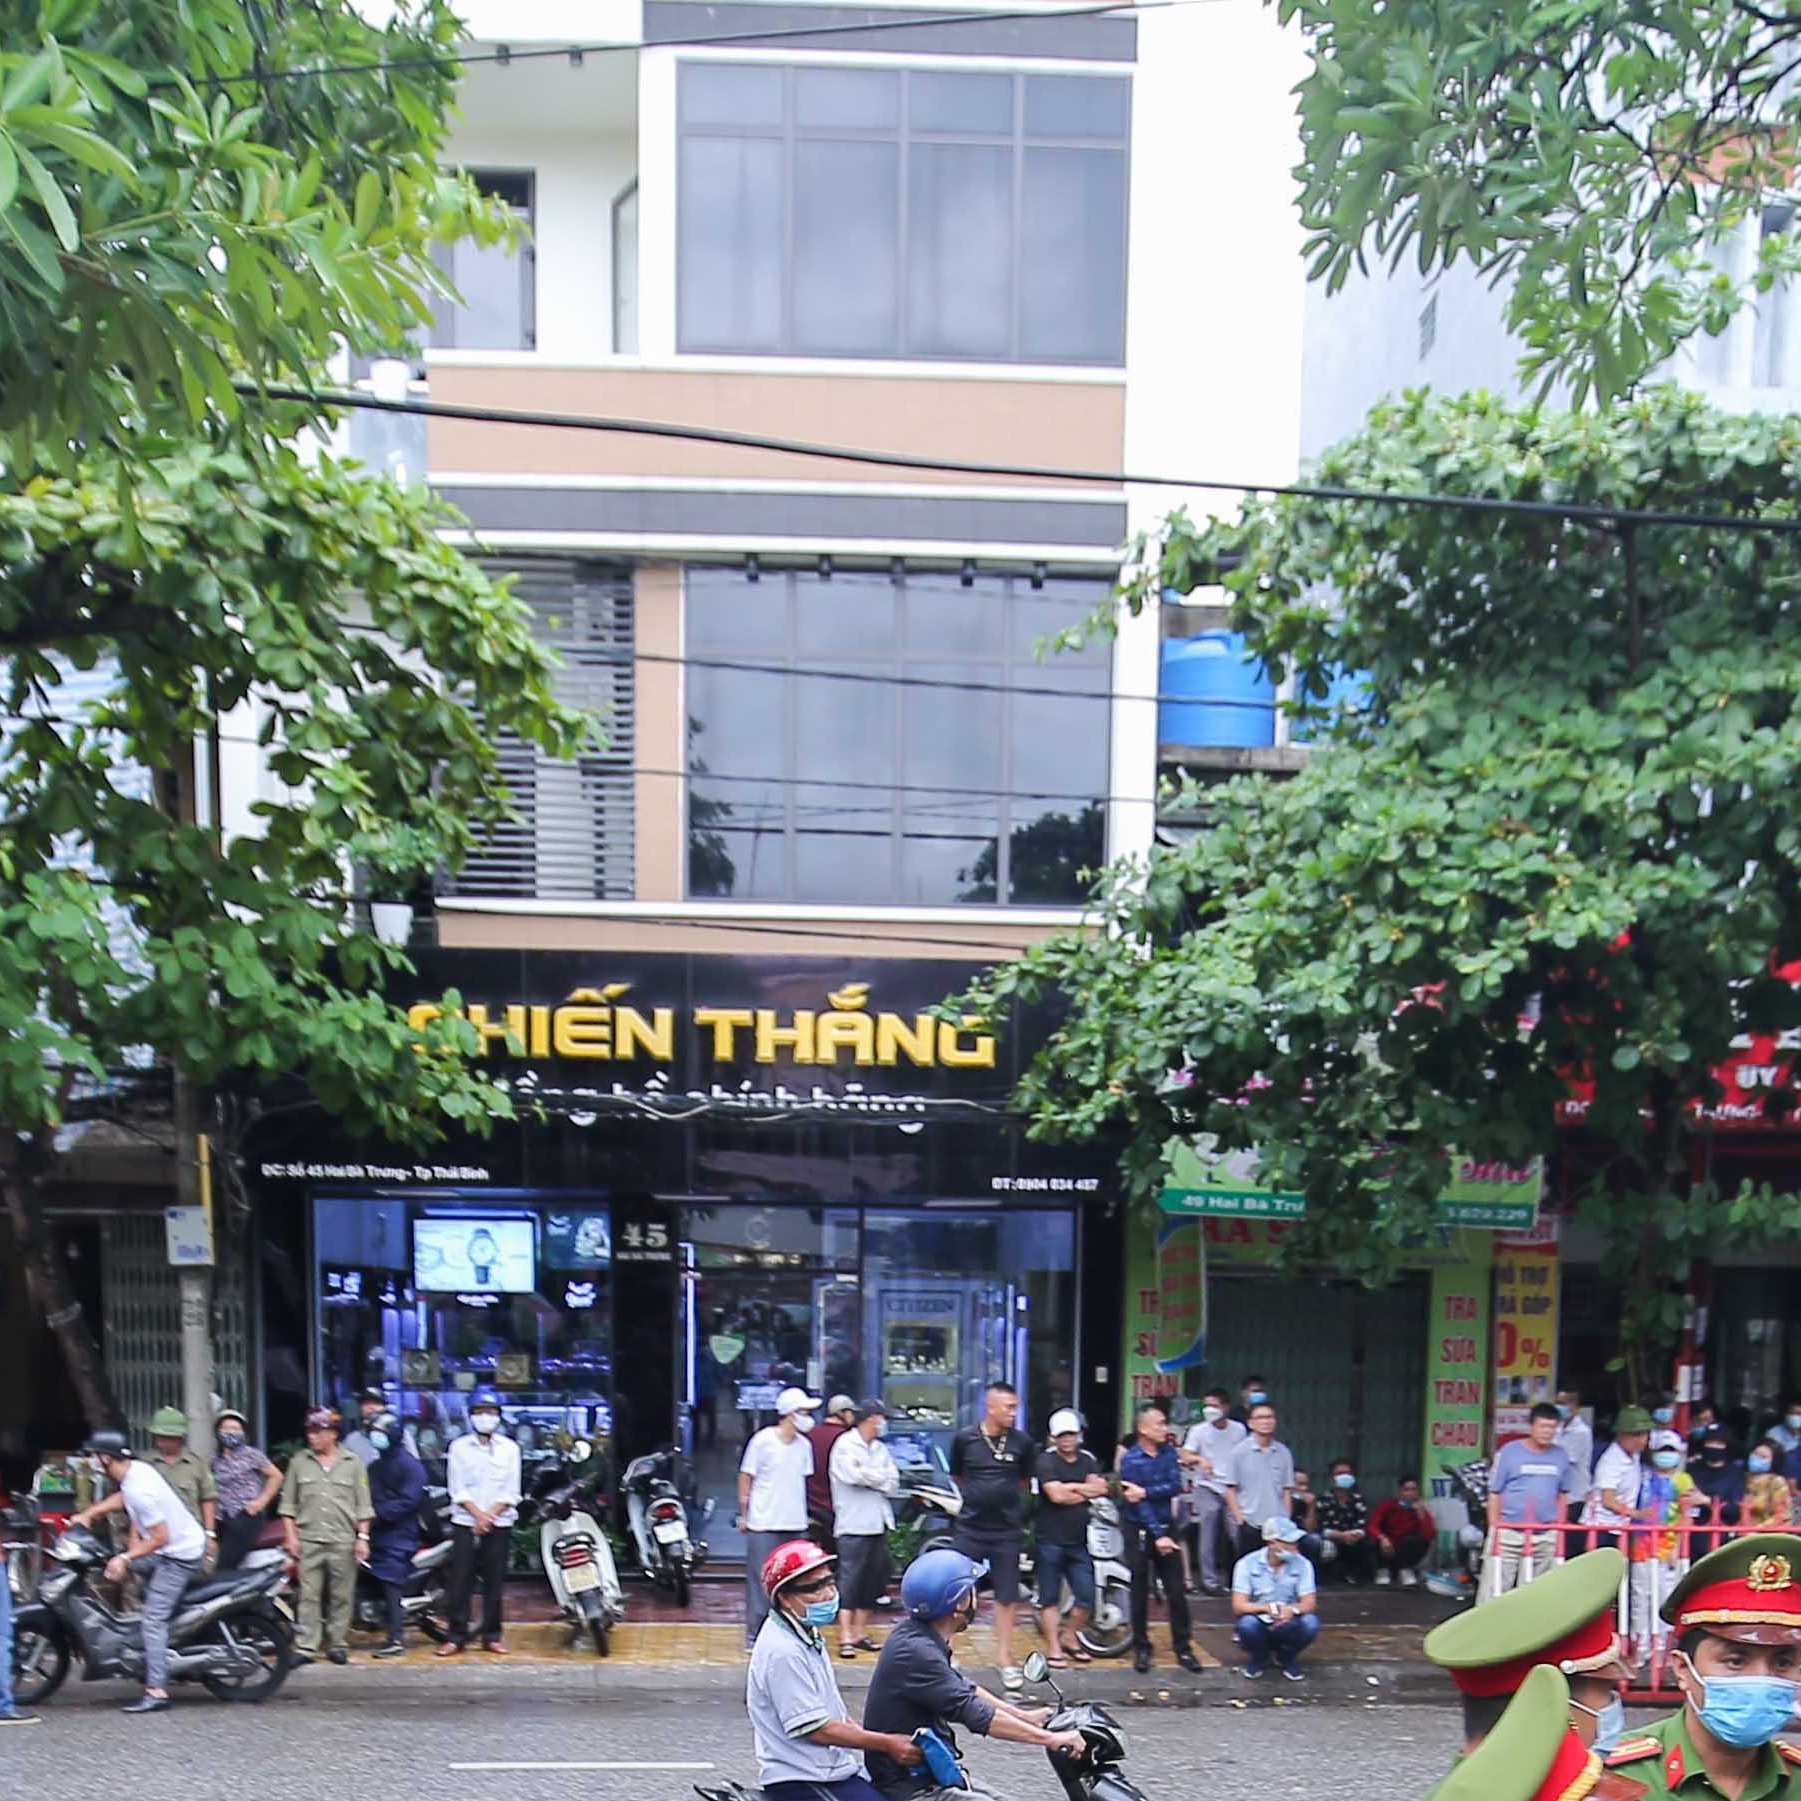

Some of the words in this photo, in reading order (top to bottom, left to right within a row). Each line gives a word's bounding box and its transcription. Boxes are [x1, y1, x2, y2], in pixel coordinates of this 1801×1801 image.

[408, 981, 674, 1062] CHIẾN
[694, 980, 996, 1069] THẮNG
[621, 1222, 669, 1248] 45
[886, 1299, 955, 1314] CITIZEN
